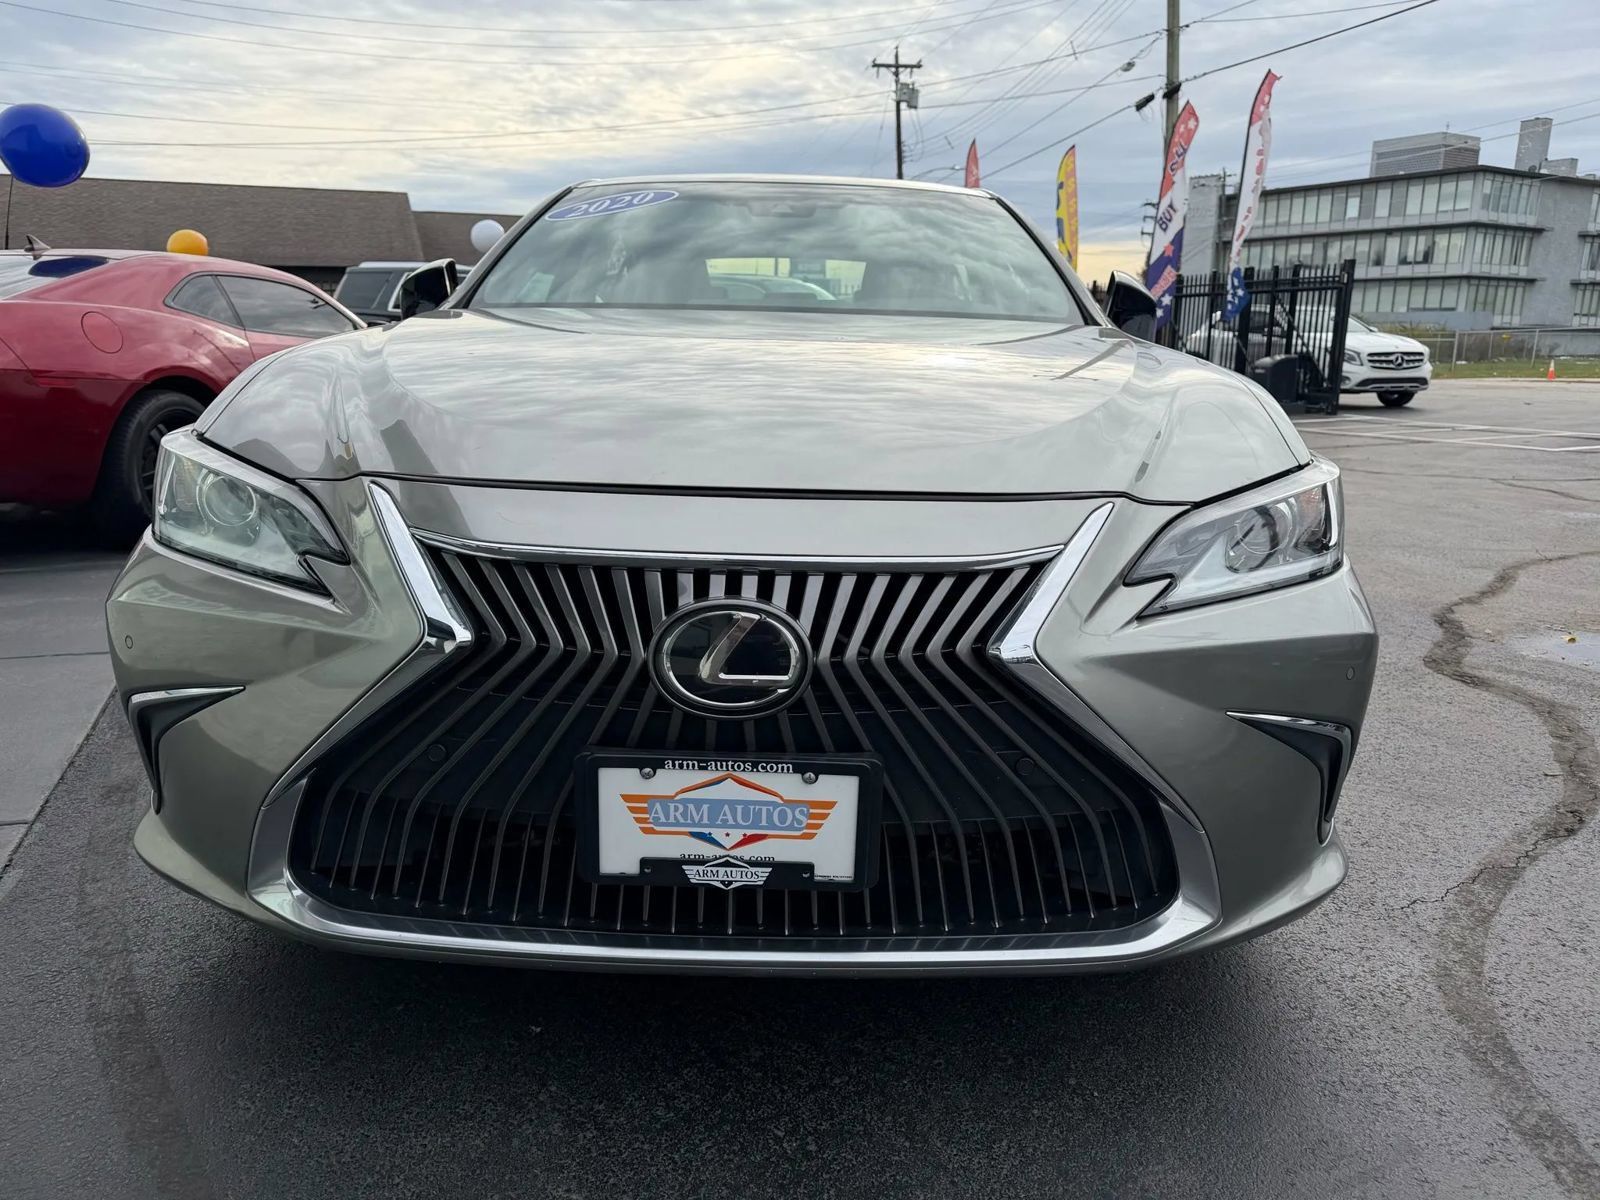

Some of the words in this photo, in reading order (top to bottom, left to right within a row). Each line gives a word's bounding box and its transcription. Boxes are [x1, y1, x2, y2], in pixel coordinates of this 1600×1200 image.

[565, 191, 655, 218] 2020
[1157, 201, 1178, 233] BUY
[664, 758, 794, 774] arm-autos.com
[648, 802, 709, 825] ARM
[715, 804, 809, 829] AUTOS
[693, 868, 720, 879] ARM
[721, 869, 760, 880] AUTOS
